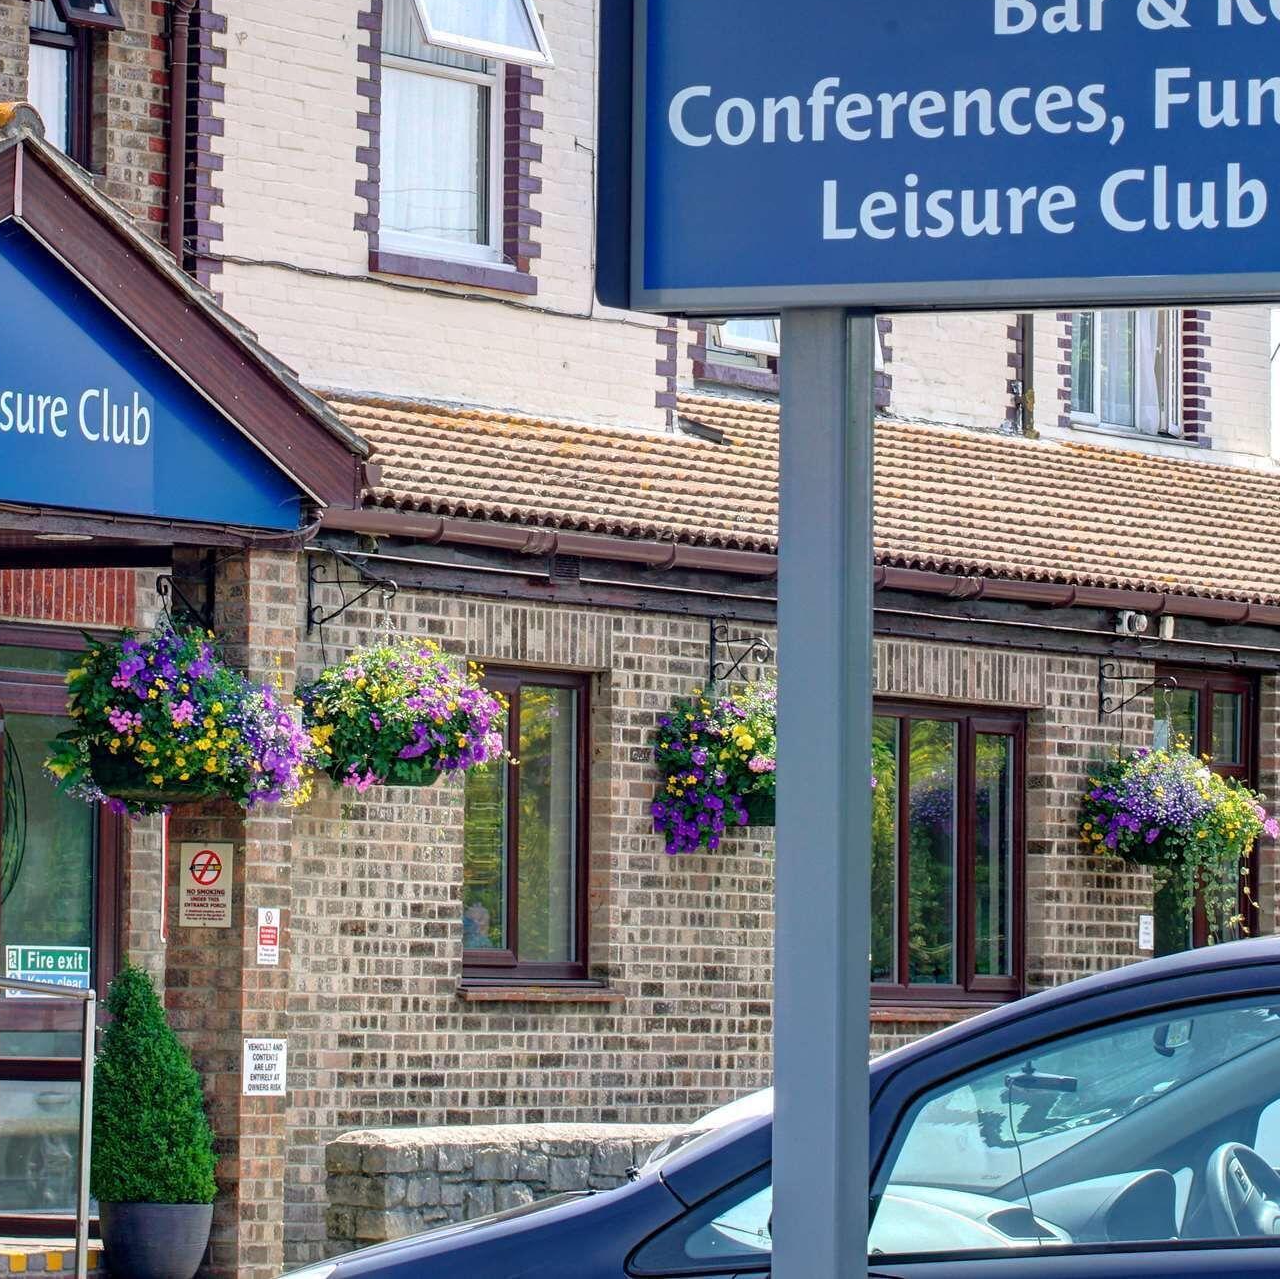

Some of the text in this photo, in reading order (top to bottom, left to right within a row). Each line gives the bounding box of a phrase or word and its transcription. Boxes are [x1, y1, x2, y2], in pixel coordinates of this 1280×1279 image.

[667, 76, 1126, 147] Conferences,
[822, 173, 1076, 241] Leisure
[1099, 161, 1268, 232] Club
[78, 387, 152, 447] Club
[27, 951, 83, 970] Fire exit
[272, 1043, 283, 1051] AND
[254, 1063, 277, 1071] ARE LEFT
[248, 1083, 282, 1091] OWNERS RISK
